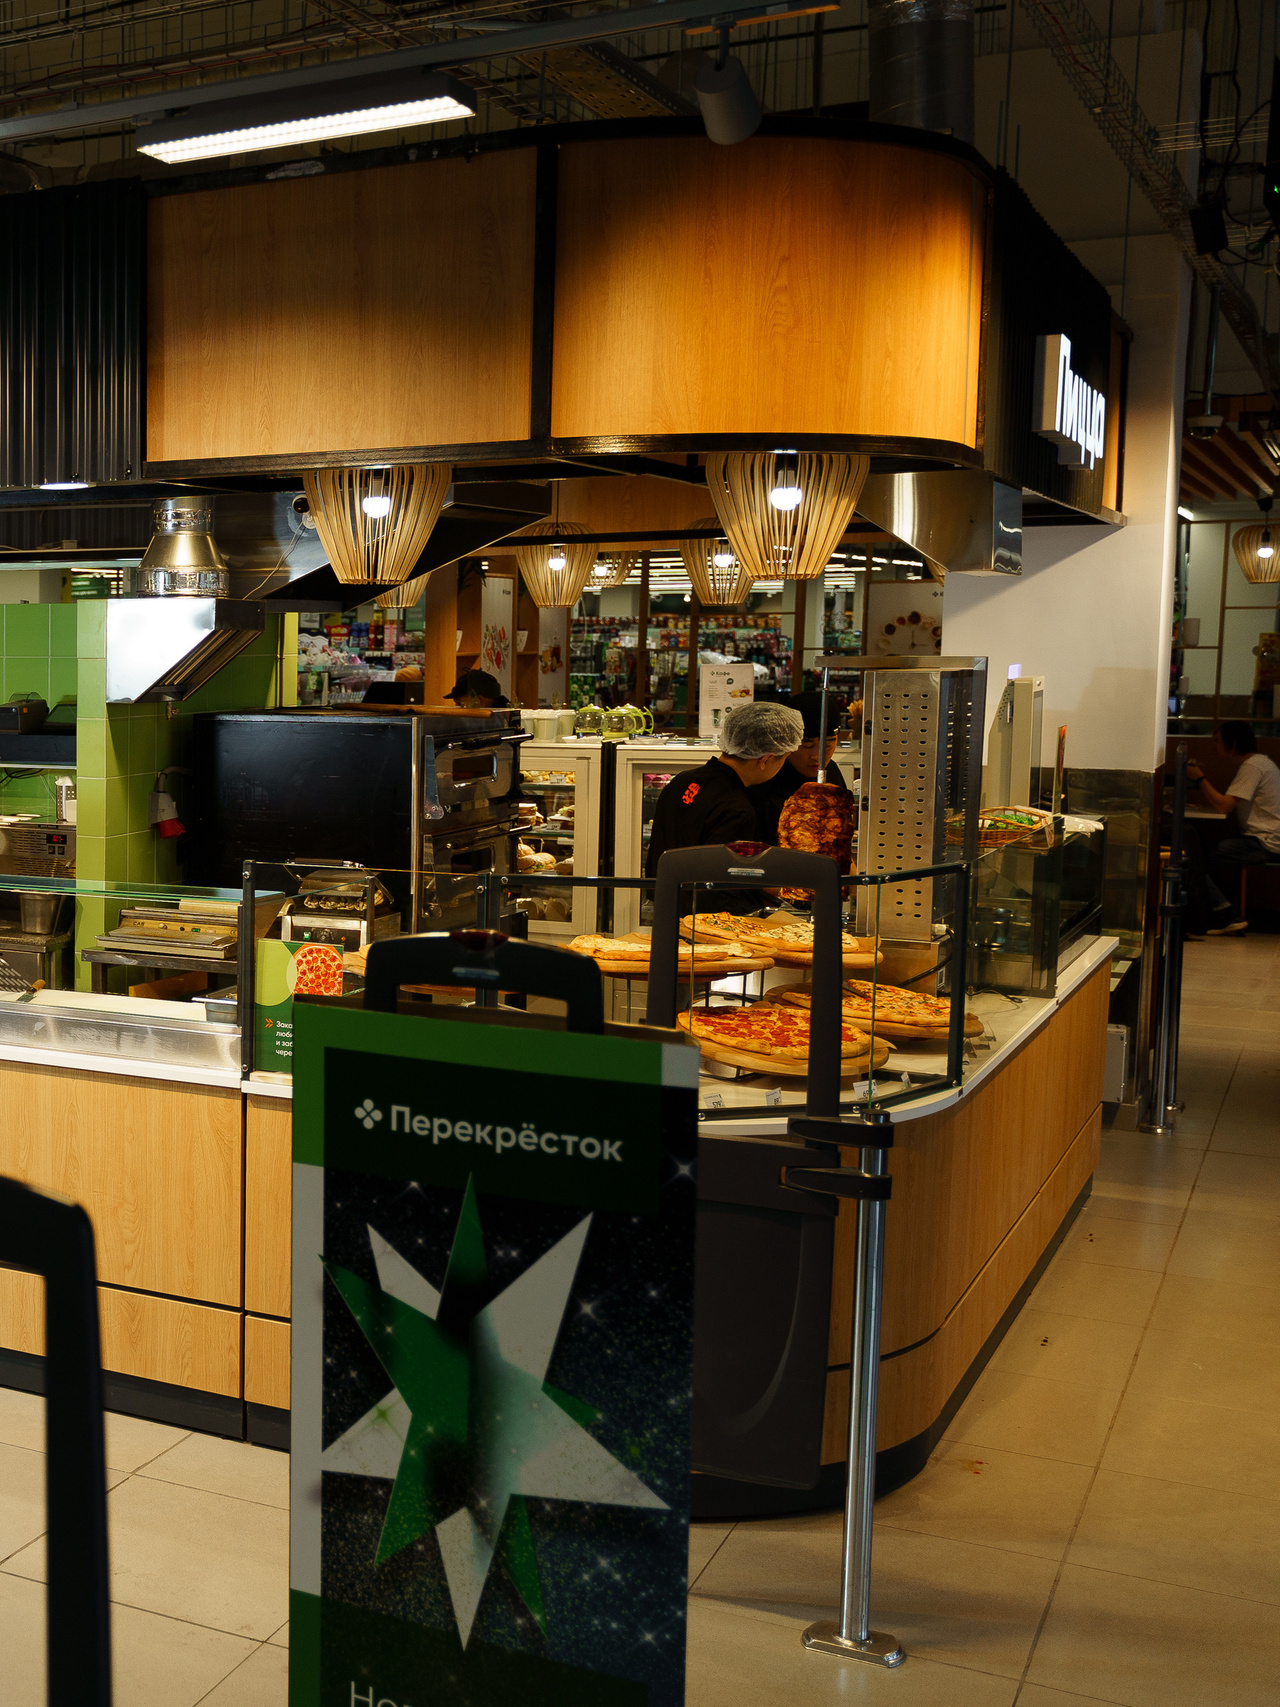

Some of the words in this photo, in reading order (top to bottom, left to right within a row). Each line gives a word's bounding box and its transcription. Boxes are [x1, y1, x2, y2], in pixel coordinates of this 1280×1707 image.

[1055, 333, 1106, 471] Пицца
[276, 1020, 293, 1029] Зака
[275, 1049, 293, 1057] чере
[390, 1103, 624, 1162] Перекрёсток
